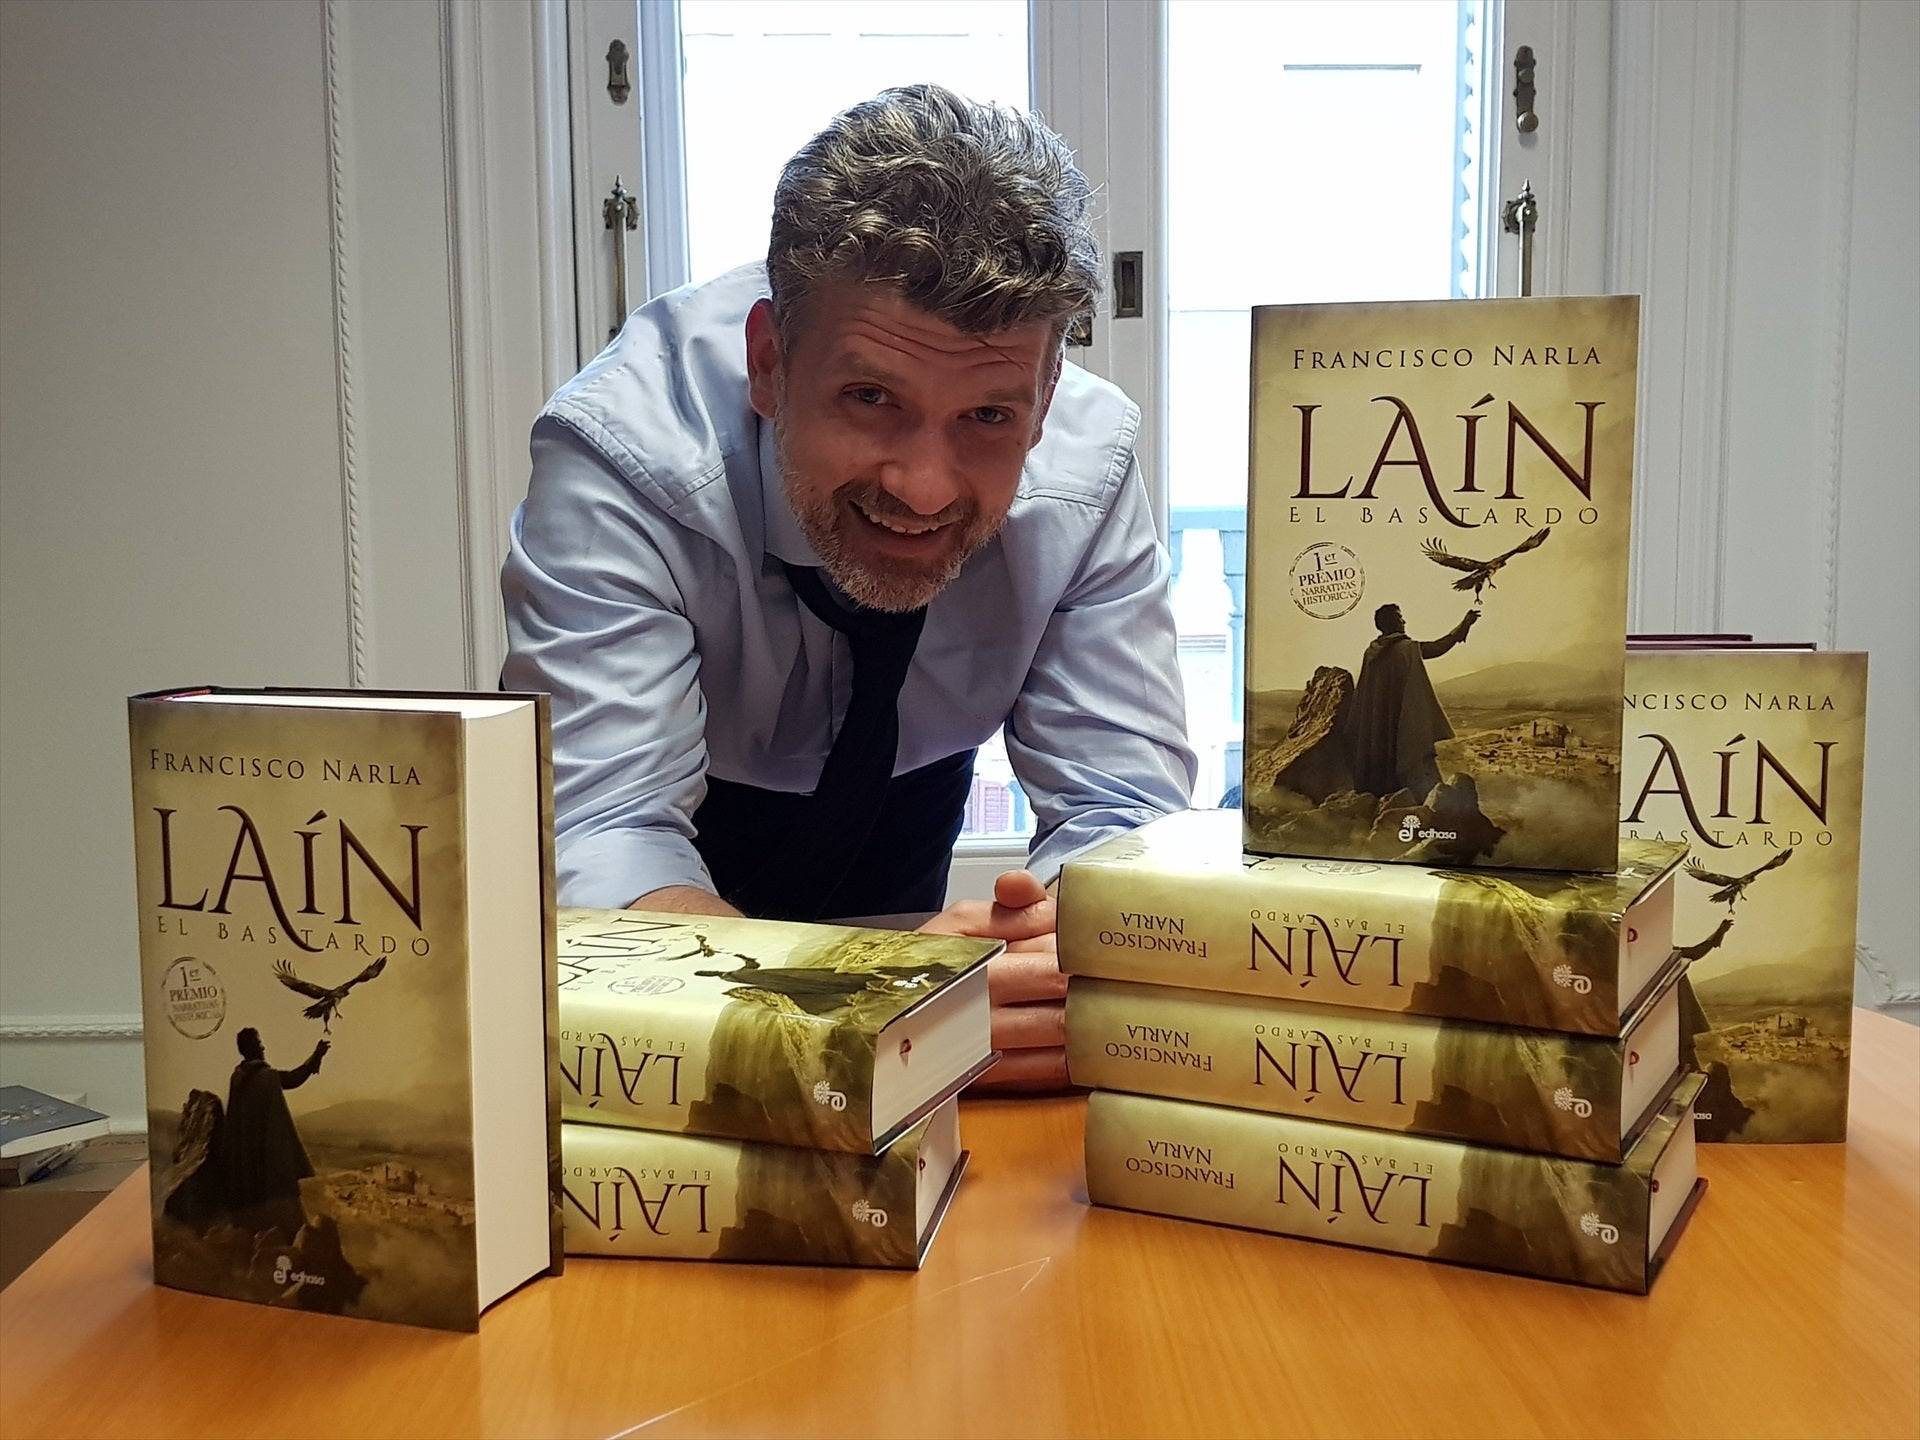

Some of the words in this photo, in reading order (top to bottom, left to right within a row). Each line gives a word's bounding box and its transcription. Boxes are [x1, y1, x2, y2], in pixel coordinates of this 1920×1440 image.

[1292, 348, 1473, 370] FRANCISCO
[1493, 344, 1602, 367] NARLA
[1290, 393, 1606, 529] LAÍN
[1288, 506, 1327, 524] EL
[1360, 506, 1599, 529] BASTARDO
[1299, 567, 1356, 587] PREMIO
[1301, 580, 1356, 597] NARRATIVAS
[1745, 692, 1835, 711] NARLA
[151, 749, 305, 780] FRANCISCO
[322, 759, 422, 785] NARLA
[1619, 733, 1839, 849] AÍN
[1418, 828, 1457, 840] edhasa
[153, 805, 429, 953] LAÍN
[1120, 912, 1185, 935] NARLA
[1385, 922, 1405, 935] EL
[158, 915, 189, 936] EL
[218, 921, 430, 957] BASTARDO
[1099, 930, 1208, 959] FRANCISCO
[1247, 914, 1404, 989] LAÍN
[169, 986, 218, 1002] PREMIO
[561, 1030, 654, 1049] BASTARD
[667, 1040, 686, 1052] EL
[1126, 1024, 1189, 1048] NARLA
[1388, 1040, 1407, 1053] EL
[1105, 1042, 1212, 1072] FRANCISCO
[1252, 1030, 1406, 1105] LAÍN
[1148, 1140, 1212, 1165] NARLA
[691, 1169, 711, 1181] EL
[1126, 1157, 1235, 1189] FRANCISCO
[1413, 1161, 1433, 1174] EL
[1275, 1150, 1432, 1228] LAÍN
